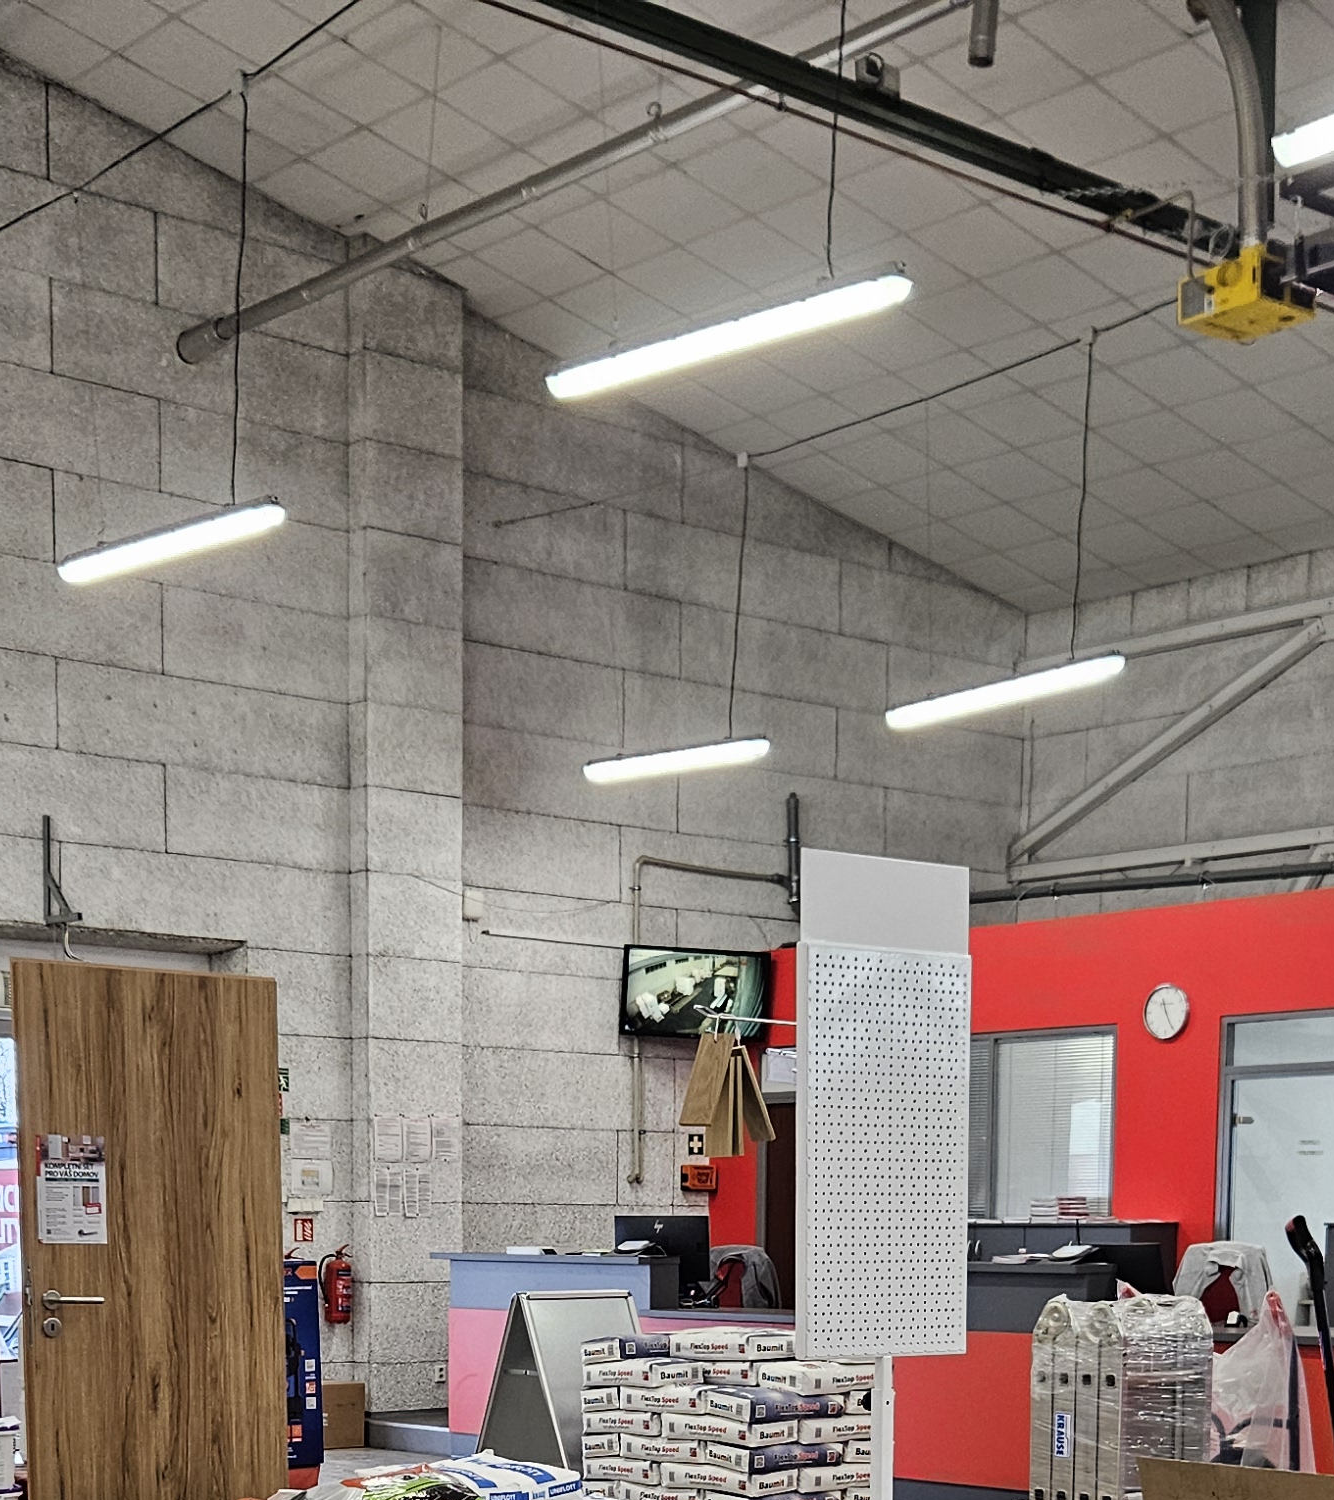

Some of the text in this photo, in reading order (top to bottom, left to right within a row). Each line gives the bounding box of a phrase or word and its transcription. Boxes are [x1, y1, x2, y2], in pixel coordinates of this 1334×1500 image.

[44, 1170, 59, 1178] PRO
[710, 1342, 729, 1351] Speed
[756, 1343, 783, 1352] Baumit
[617, 1369, 633, 1377] Speed
[660, 1370, 688, 1380] Baumit
[761, 1372, 787, 1384] Baumit
[1055, 1414, 1066, 1456] KRAUSE
[549, 1483, 577, 1496] UNIFLOTT
